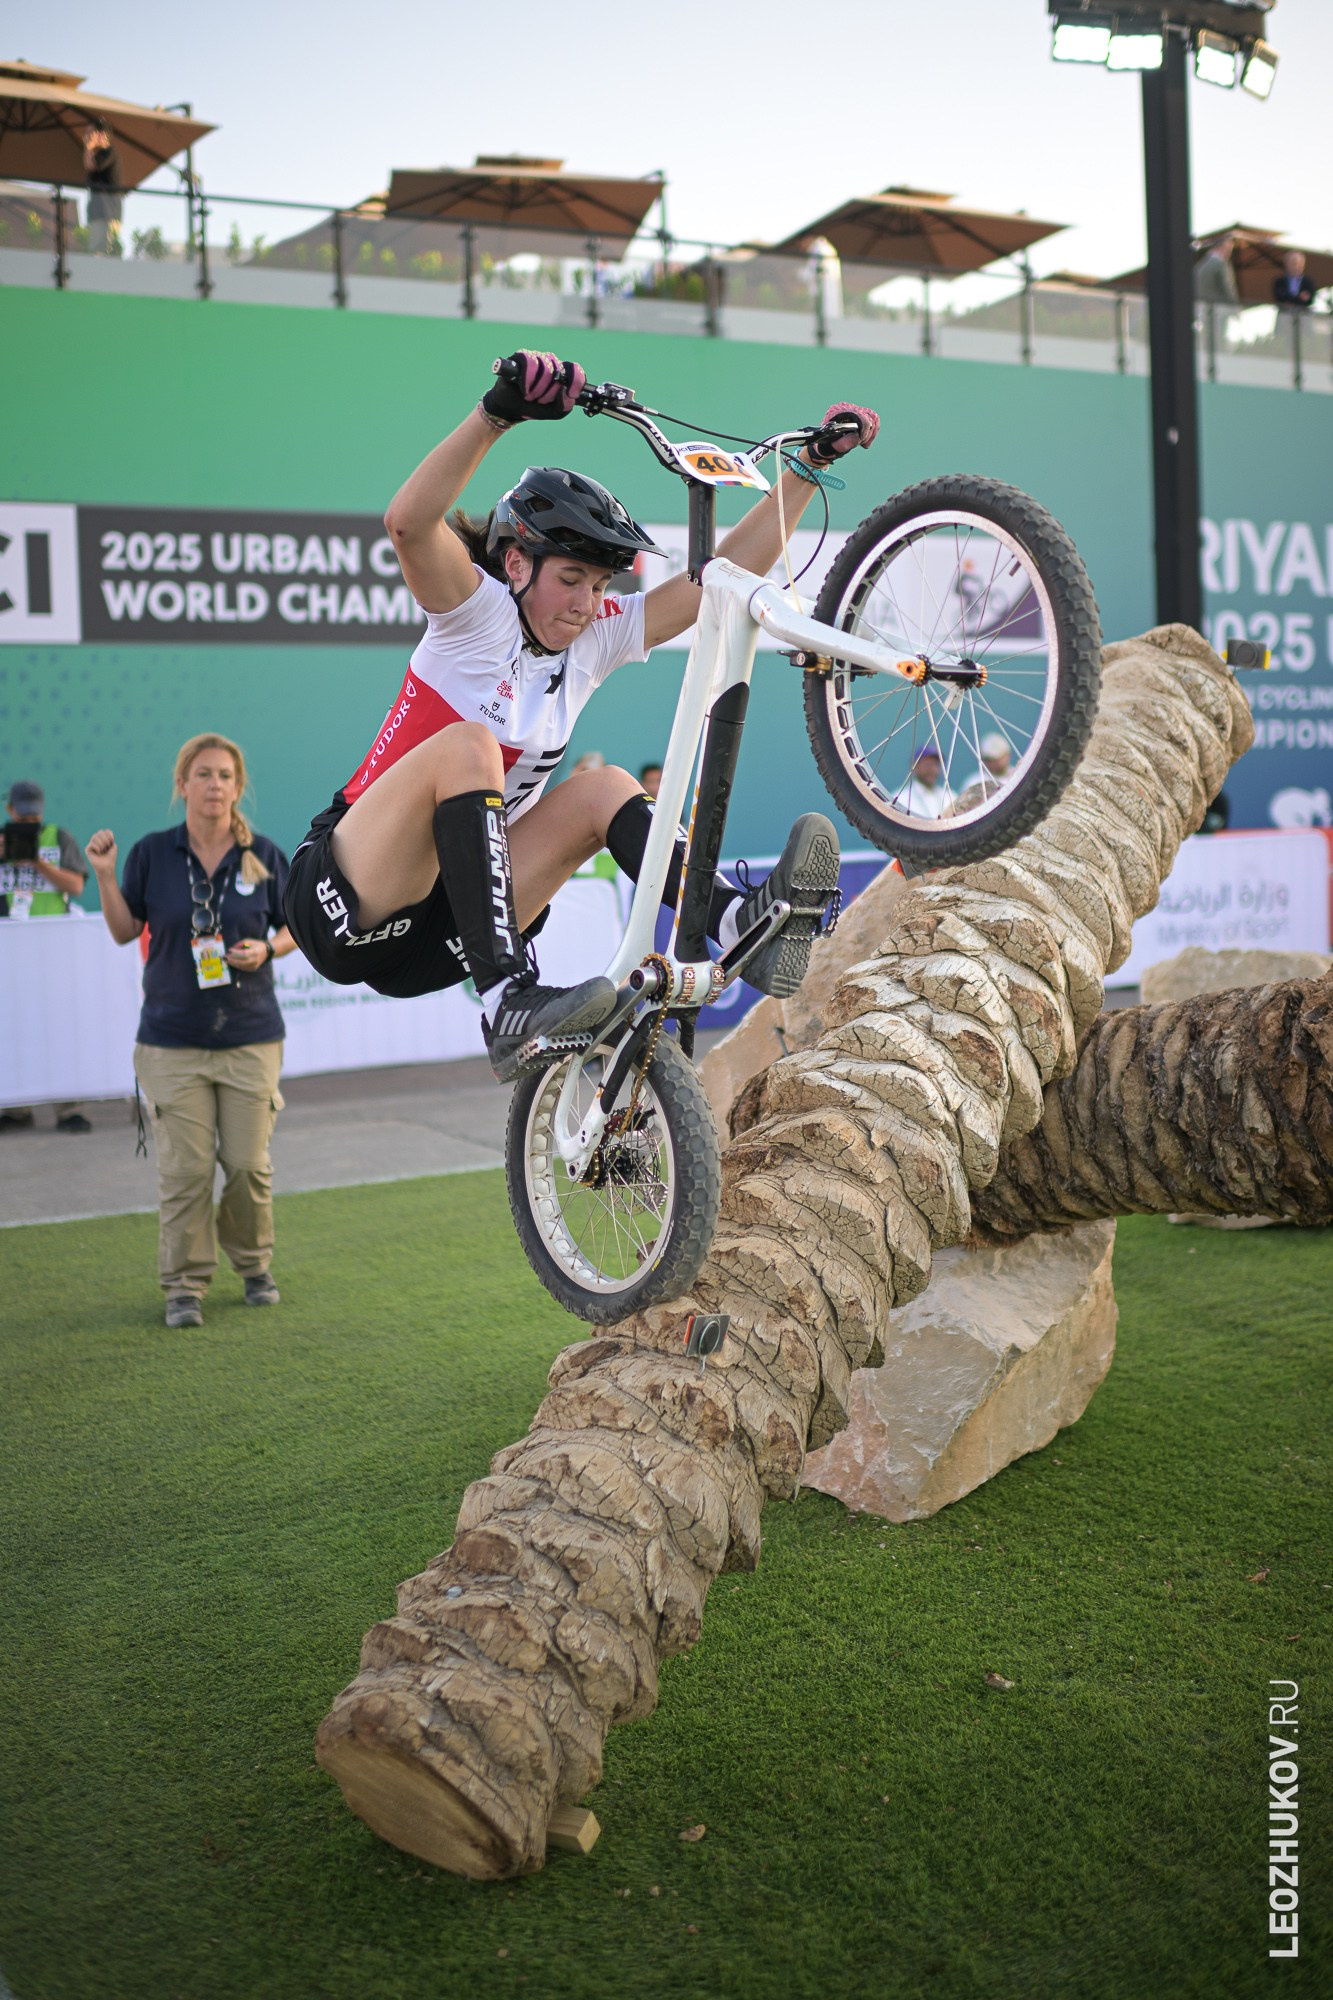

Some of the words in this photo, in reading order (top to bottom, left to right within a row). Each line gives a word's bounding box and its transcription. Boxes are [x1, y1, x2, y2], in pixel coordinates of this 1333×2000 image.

[101, 532, 202, 572] 2025
[211, 534, 361, 577] URBAN
[101, 580, 269, 622] WORLD
[1203, 610, 1316, 672] 025
[370, 699, 411, 768] TUDOR
[479, 703, 507, 726] TUDOR
[486, 810, 514, 956] JUUMP
